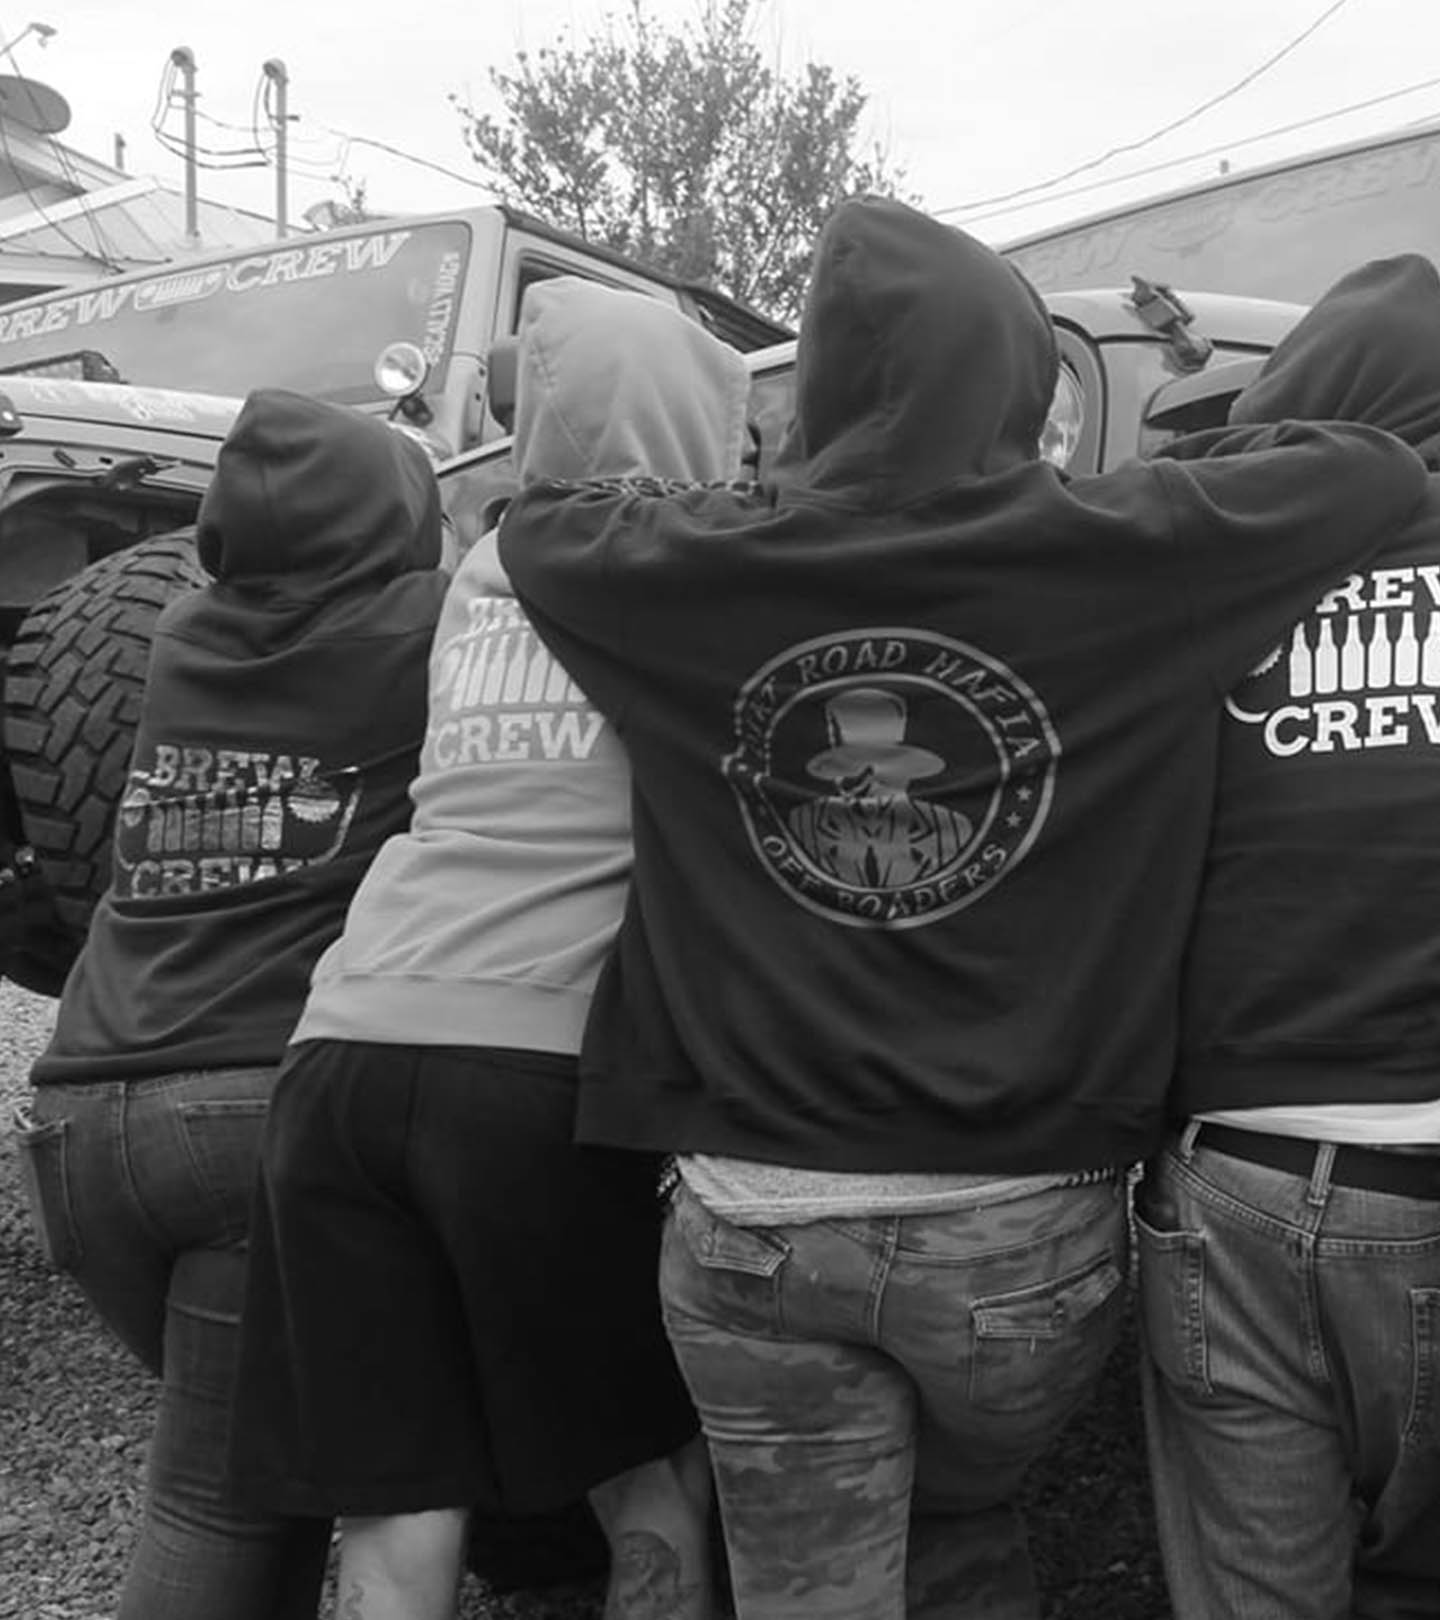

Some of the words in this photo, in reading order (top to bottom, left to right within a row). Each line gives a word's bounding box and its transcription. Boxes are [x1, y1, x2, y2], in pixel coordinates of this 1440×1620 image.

[0, 285, 137, 343] REW
[226, 231, 412, 292] CREW
[433, 710, 606, 767] CREW
[796, 639, 907, 686] ROAD
[923, 650, 1041, 760] MAFIA
[837, 842, 1008, 921] ROADERS
